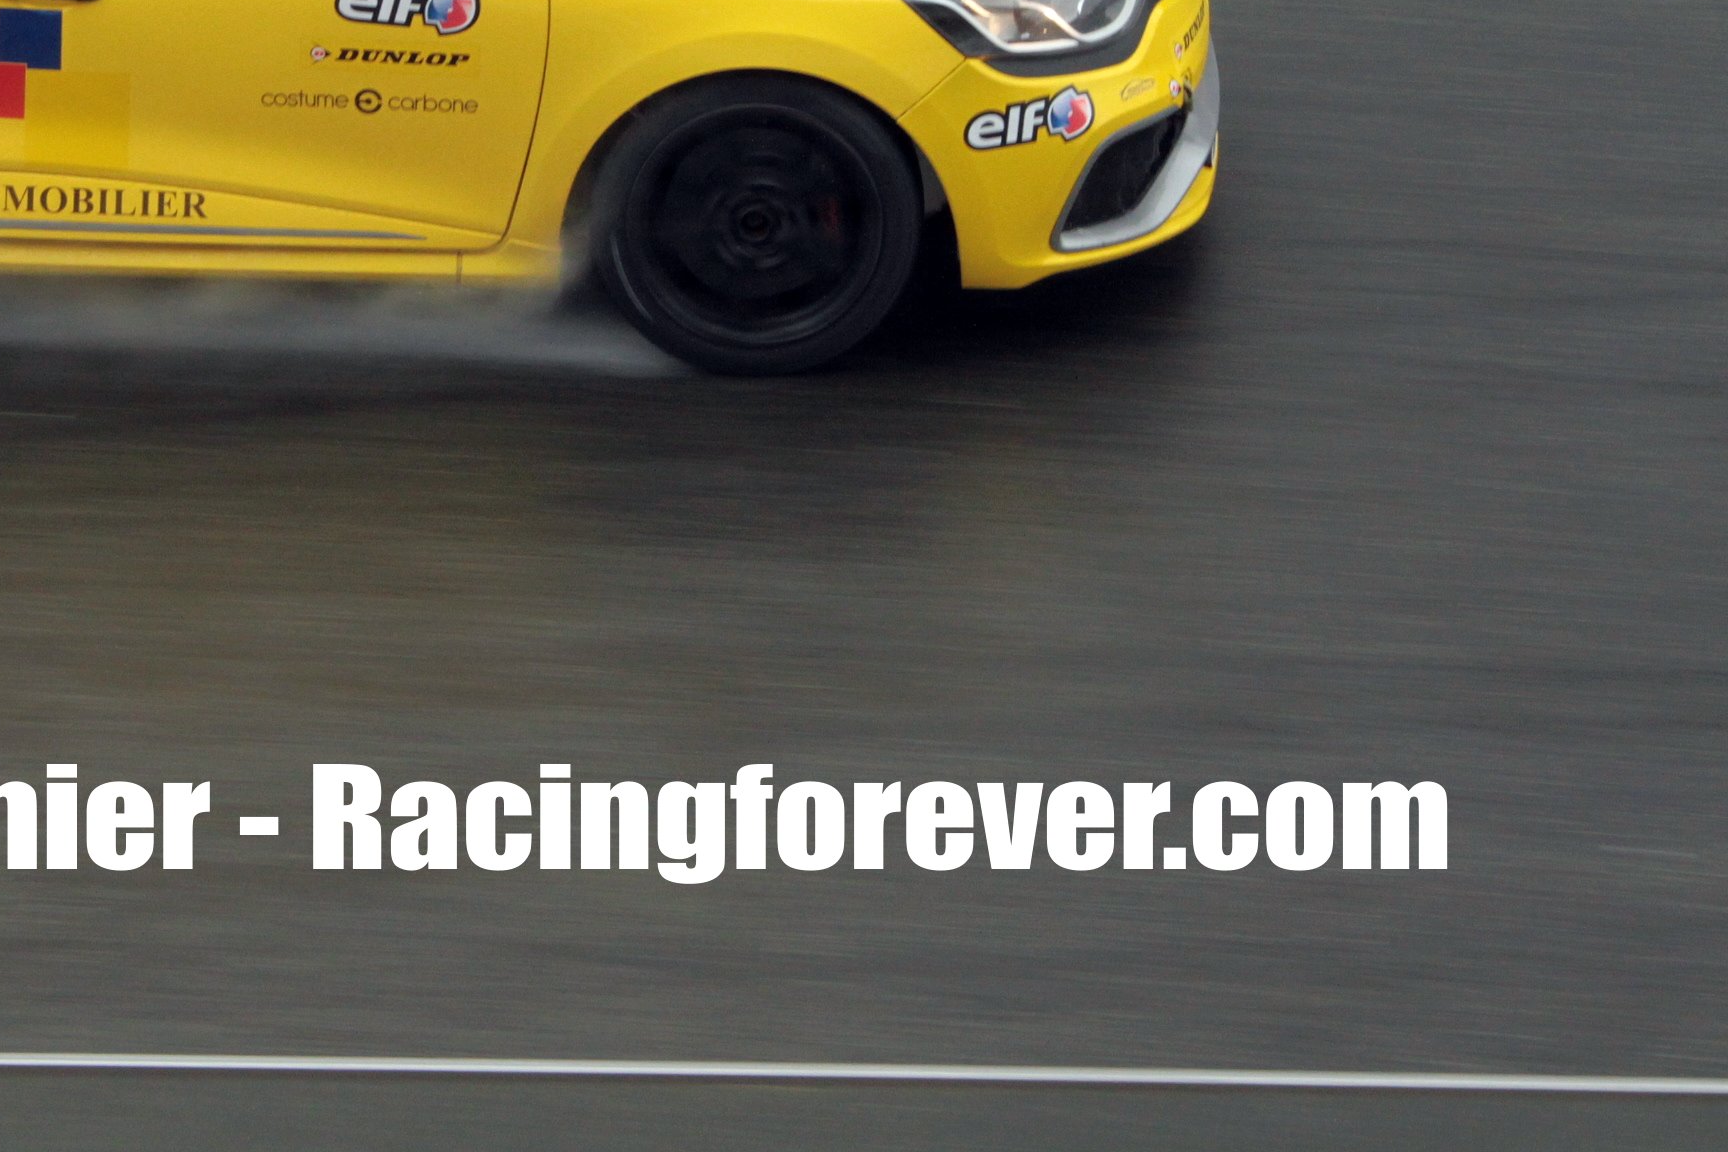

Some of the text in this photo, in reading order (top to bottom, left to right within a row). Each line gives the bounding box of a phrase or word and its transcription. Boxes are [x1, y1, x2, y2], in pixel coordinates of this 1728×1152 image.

[335, 47, 471, 66] DUNLOP
[261, 89, 479, 114] costume carbone
[966, 98, 1047, 149] elf
